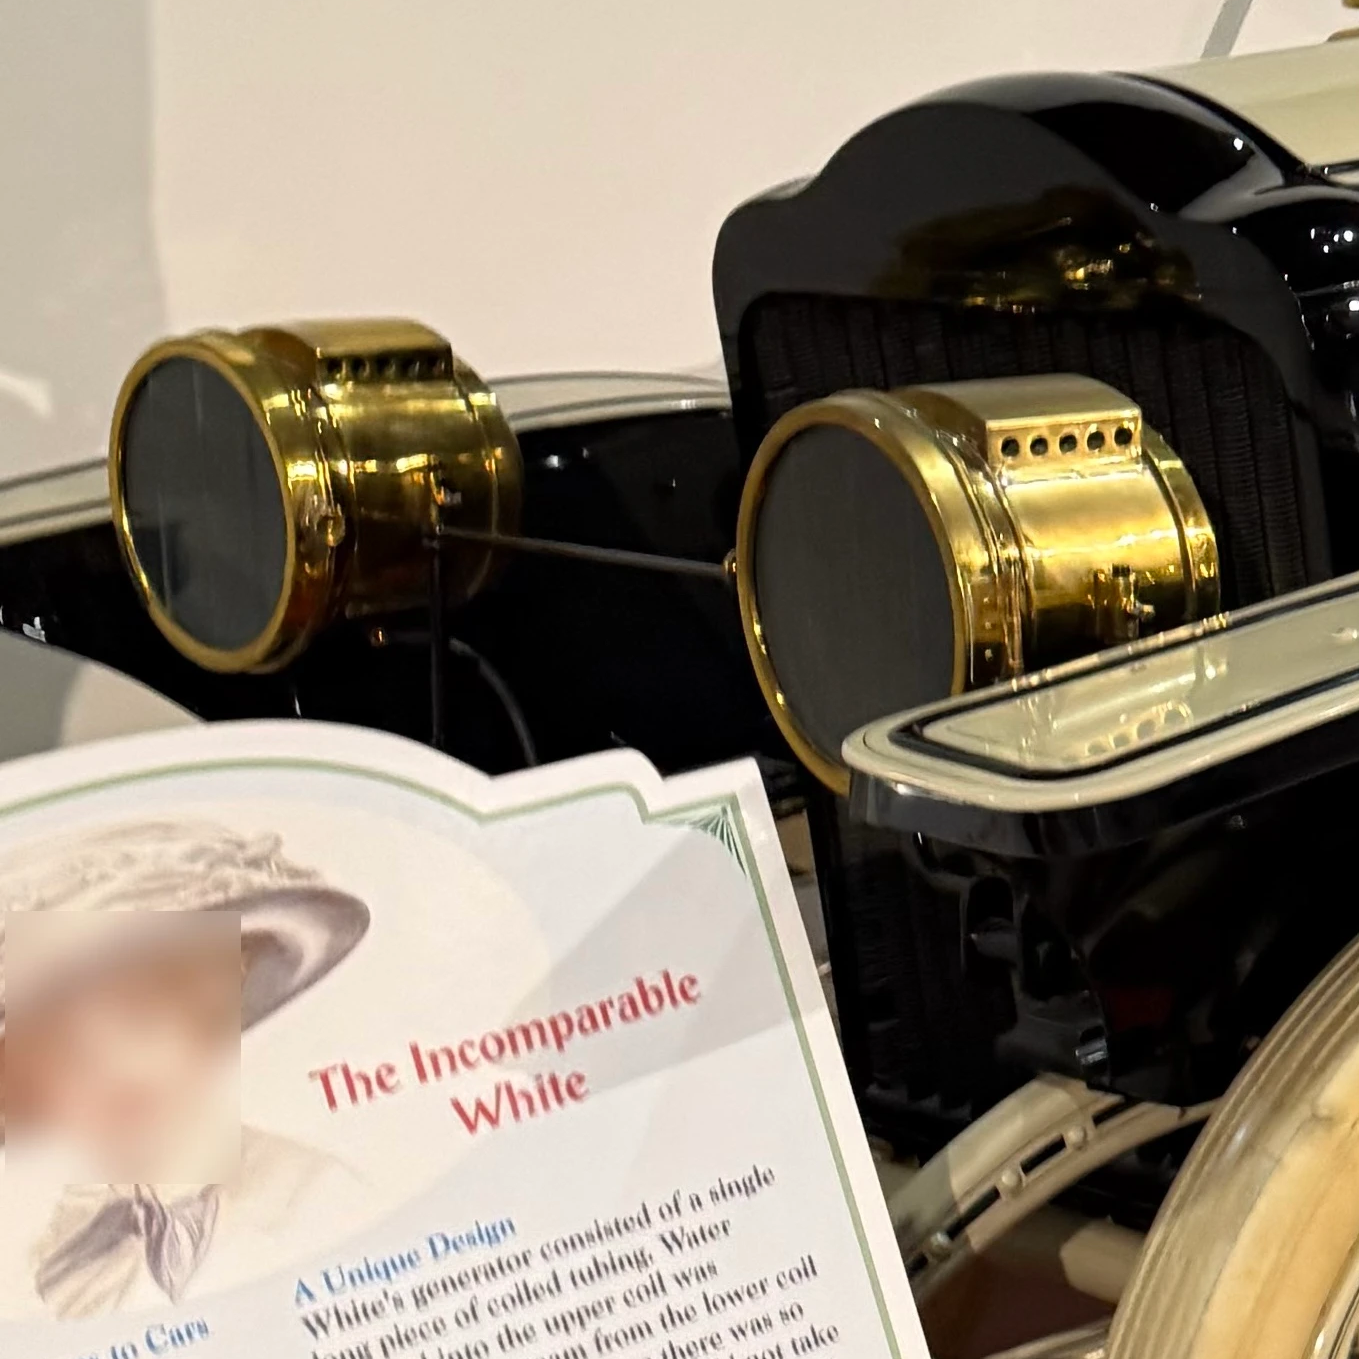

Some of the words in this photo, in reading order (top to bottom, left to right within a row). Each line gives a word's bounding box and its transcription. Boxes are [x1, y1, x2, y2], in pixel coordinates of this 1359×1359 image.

[309, 1061, 399, 1113] The
[408, 970, 699, 1085] Incomparable
[451, 1072, 588, 1136] White
[295, 1278, 316, 1306] A
[322, 1249, 421, 1295] Unique
[427, 1218, 517, 1262] Design
[410, 1248, 532, 1313] generator
[539, 1201, 652, 1263] consisted
[658, 1189, 682, 1222] of
[688, 1192, 704, 1213] a
[708, 1164, 776, 1206] single
[453, 1294, 481, 1330] of
[486, 1268, 563, 1318] coiled
[657, 1218, 731, 1257] Water
[145, 1321, 209, 1354] Cars
[496, 1323, 537, 1354] the
[542, 1295, 616, 1337] upper
[622, 1268, 669, 1309] coil
[671, 1260, 719, 1291] was
[592, 1320, 655, 1357] from
[658, 1303, 698, 1334] the
[701, 1276, 769, 1317] lower
[775, 1254, 818, 1290] coil
[728, 1312, 774, 1343] was
[778, 1302, 805, 1326] so
[790, 1323, 839, 1357] take
